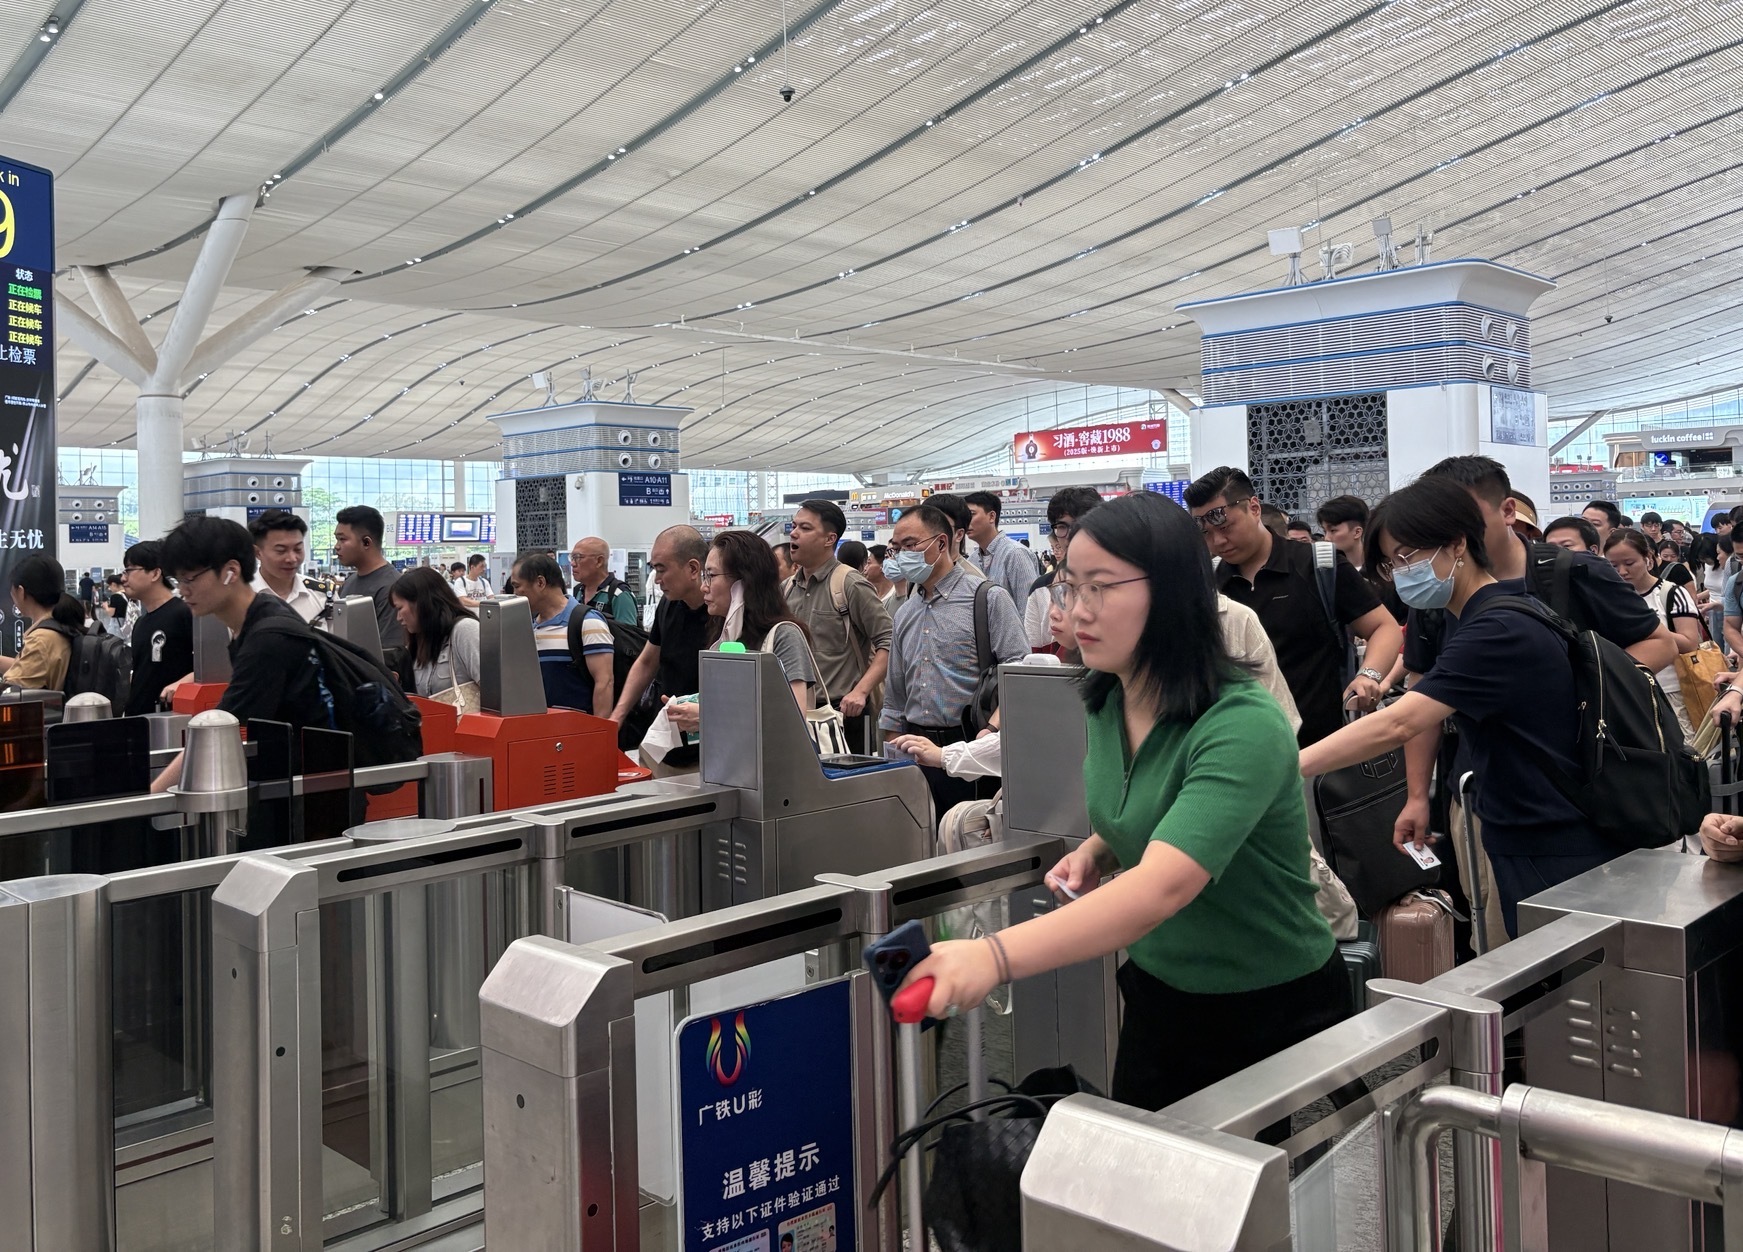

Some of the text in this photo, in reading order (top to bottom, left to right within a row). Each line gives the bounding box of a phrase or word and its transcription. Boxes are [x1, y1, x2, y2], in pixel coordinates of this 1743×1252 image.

[8, 170, 20, 187] in
[15, 268, 34, 282] 状态
[8, 299, 42, 315] 正在候车
[8, 315, 42, 331] 正在候车
[8, 331, 43, 347] 正在候车
[1053, 427, 1131, 448] 习酒·窖藏1988
[1651, 434, 1676, 444] luckin
[1676, 433, 1702, 442] coffee
[883, 491, 915, 499] McDonald's
[698, 1088, 763, 1126] 广铁U彩
[722, 1142, 820, 1200] 温馨提示
[701, 1174, 841, 1242] 支持以下证件验证通过
